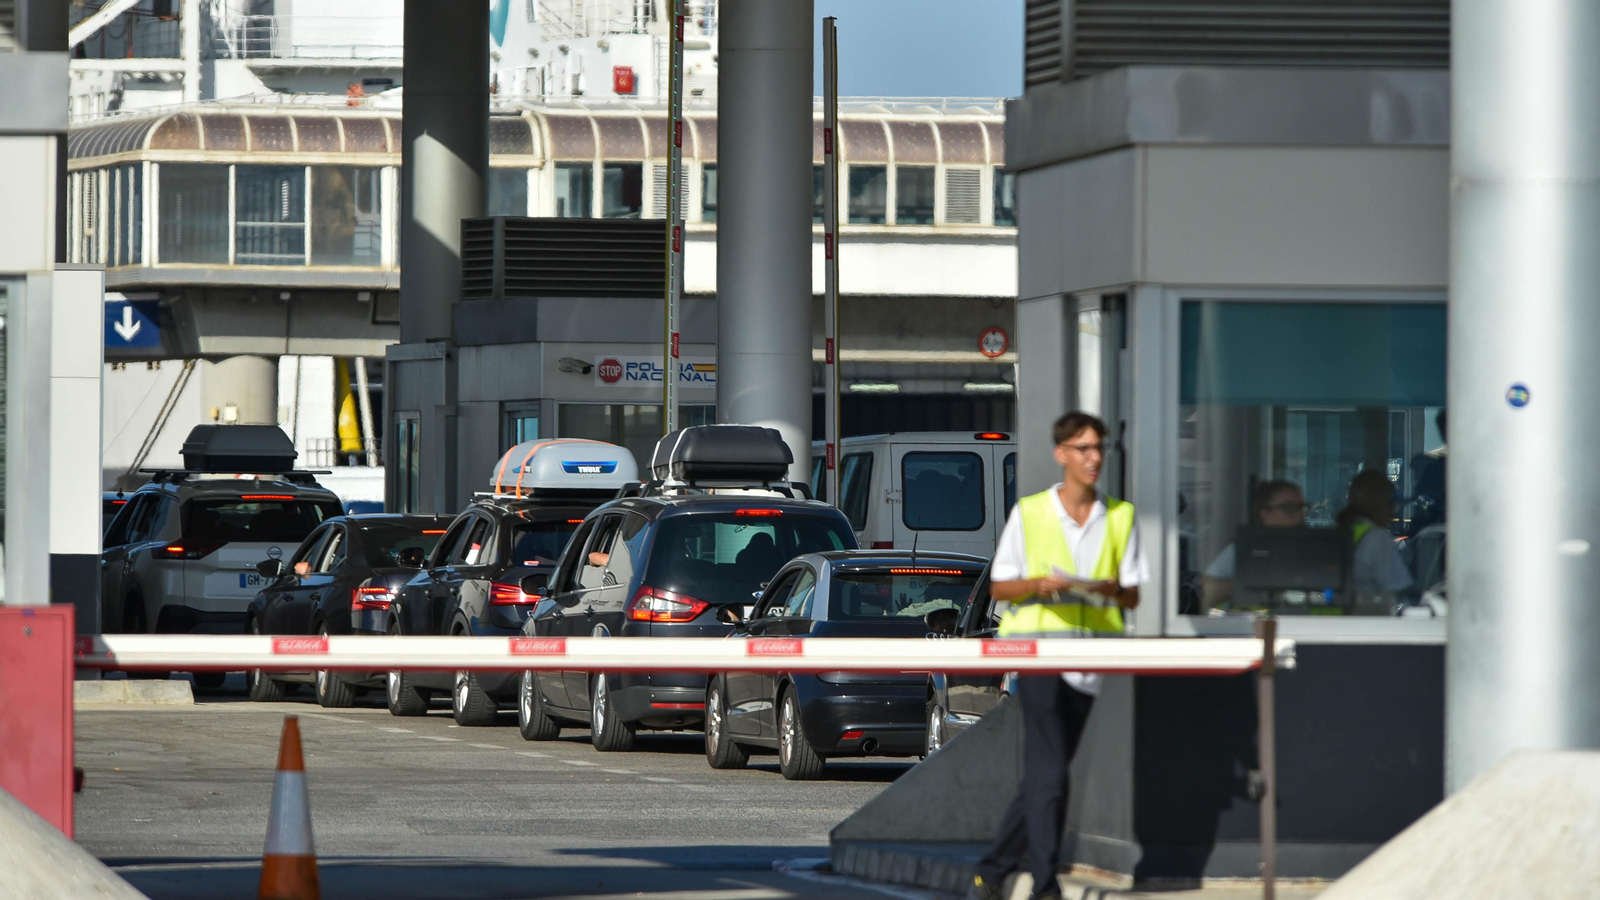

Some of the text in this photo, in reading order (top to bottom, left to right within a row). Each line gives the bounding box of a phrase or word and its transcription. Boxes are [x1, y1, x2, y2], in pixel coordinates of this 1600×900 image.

[600, 365, 621, 377] STOP
[626, 362, 695, 372] POLIA
[626, 372, 716, 382] NACNAL
